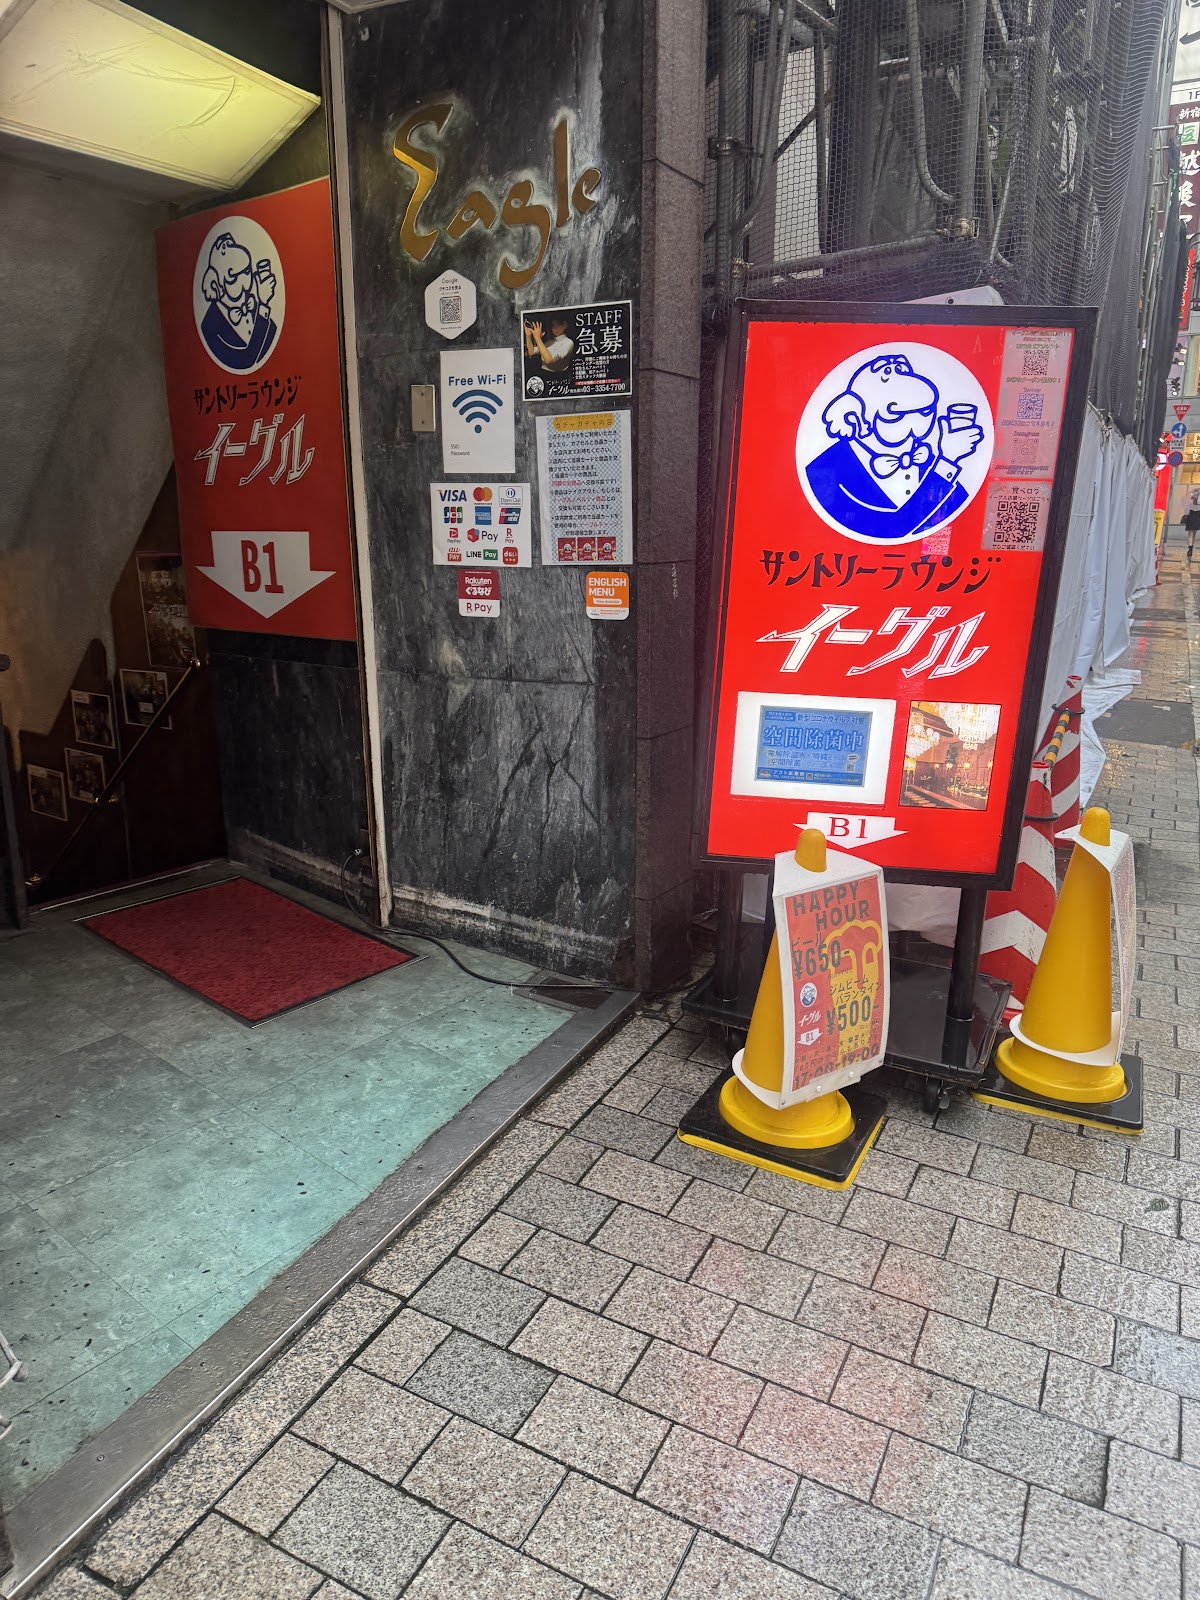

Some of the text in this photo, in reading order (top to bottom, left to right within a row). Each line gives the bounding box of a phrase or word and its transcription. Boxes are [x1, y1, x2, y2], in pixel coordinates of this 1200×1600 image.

[393, 103, 601, 289] Eagle
[575, 309, 623, 327] STAFF
[575, 325, 622, 355] 急募
[448, 374, 507, 386] Free Wi-Fi
[583, 383, 626, 393] 03-3354-7700
[193, 376, 303, 415] サントリーラウンジ
[193, 413, 316, 487] イーグル
[437, 489, 467, 502] VISA
[1012, 486, 1039, 494] 食べログ
[481, 530, 498, 542] Pay
[241, 539, 284, 594] B1
[760, 549, 1002, 594] サントリーラウンジ
[465, 576, 492, 585] Rakuten
[588, 577, 627, 586] ENGLISH
[465, 586, 492, 596] ぐるなび
[588, 587, 615, 596] MENU
[474, 602, 492, 613] Pay
[755, 603, 990, 679] イーグル
[763, 725, 865, 752] 空間除菌中
[827, 815, 869, 840] B1
[792, 880, 859, 917] HAPPY
[815, 899, 870, 932] HOUR
[791, 931, 825, 949] ビール
[829, 974, 869, 996] ジムビーム
[835, 981, 882, 1005] バランタイン
[805, 1032, 814, 1043] B1
